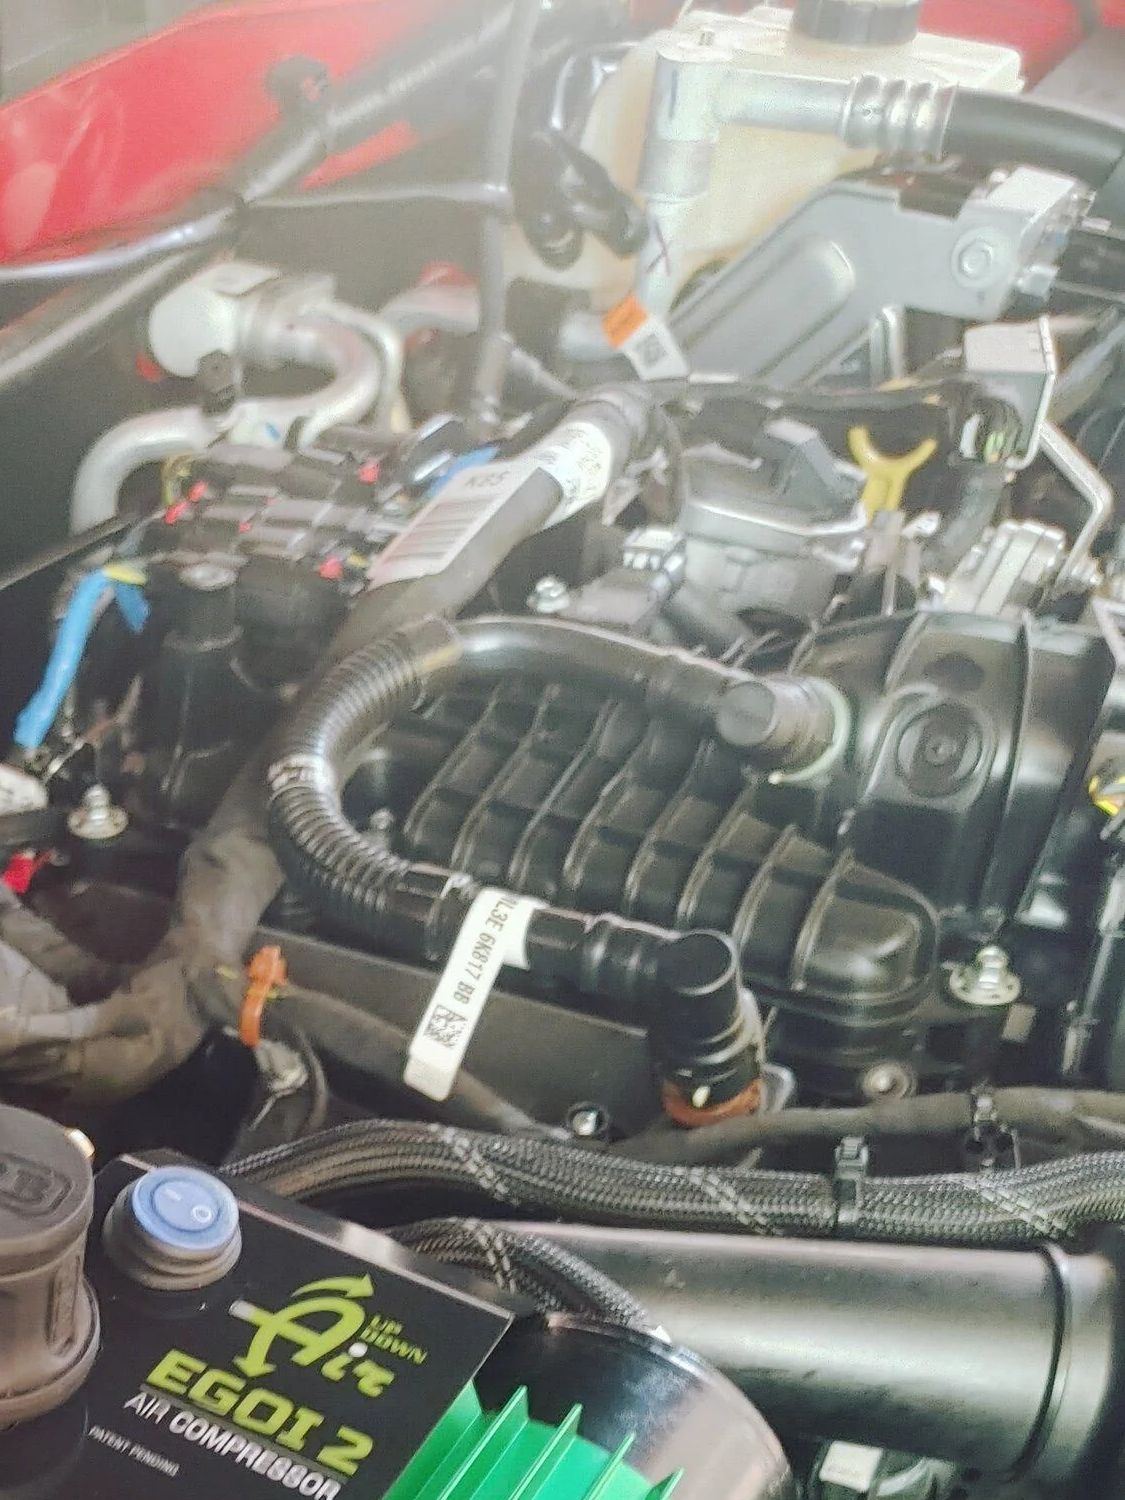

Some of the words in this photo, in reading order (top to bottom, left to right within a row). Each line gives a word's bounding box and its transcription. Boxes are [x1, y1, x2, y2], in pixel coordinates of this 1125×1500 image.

[465, 932, 496, 980] 6K817
[122, 1391, 173, 1425] AIR
[315, 1424, 374, 1476] 2
